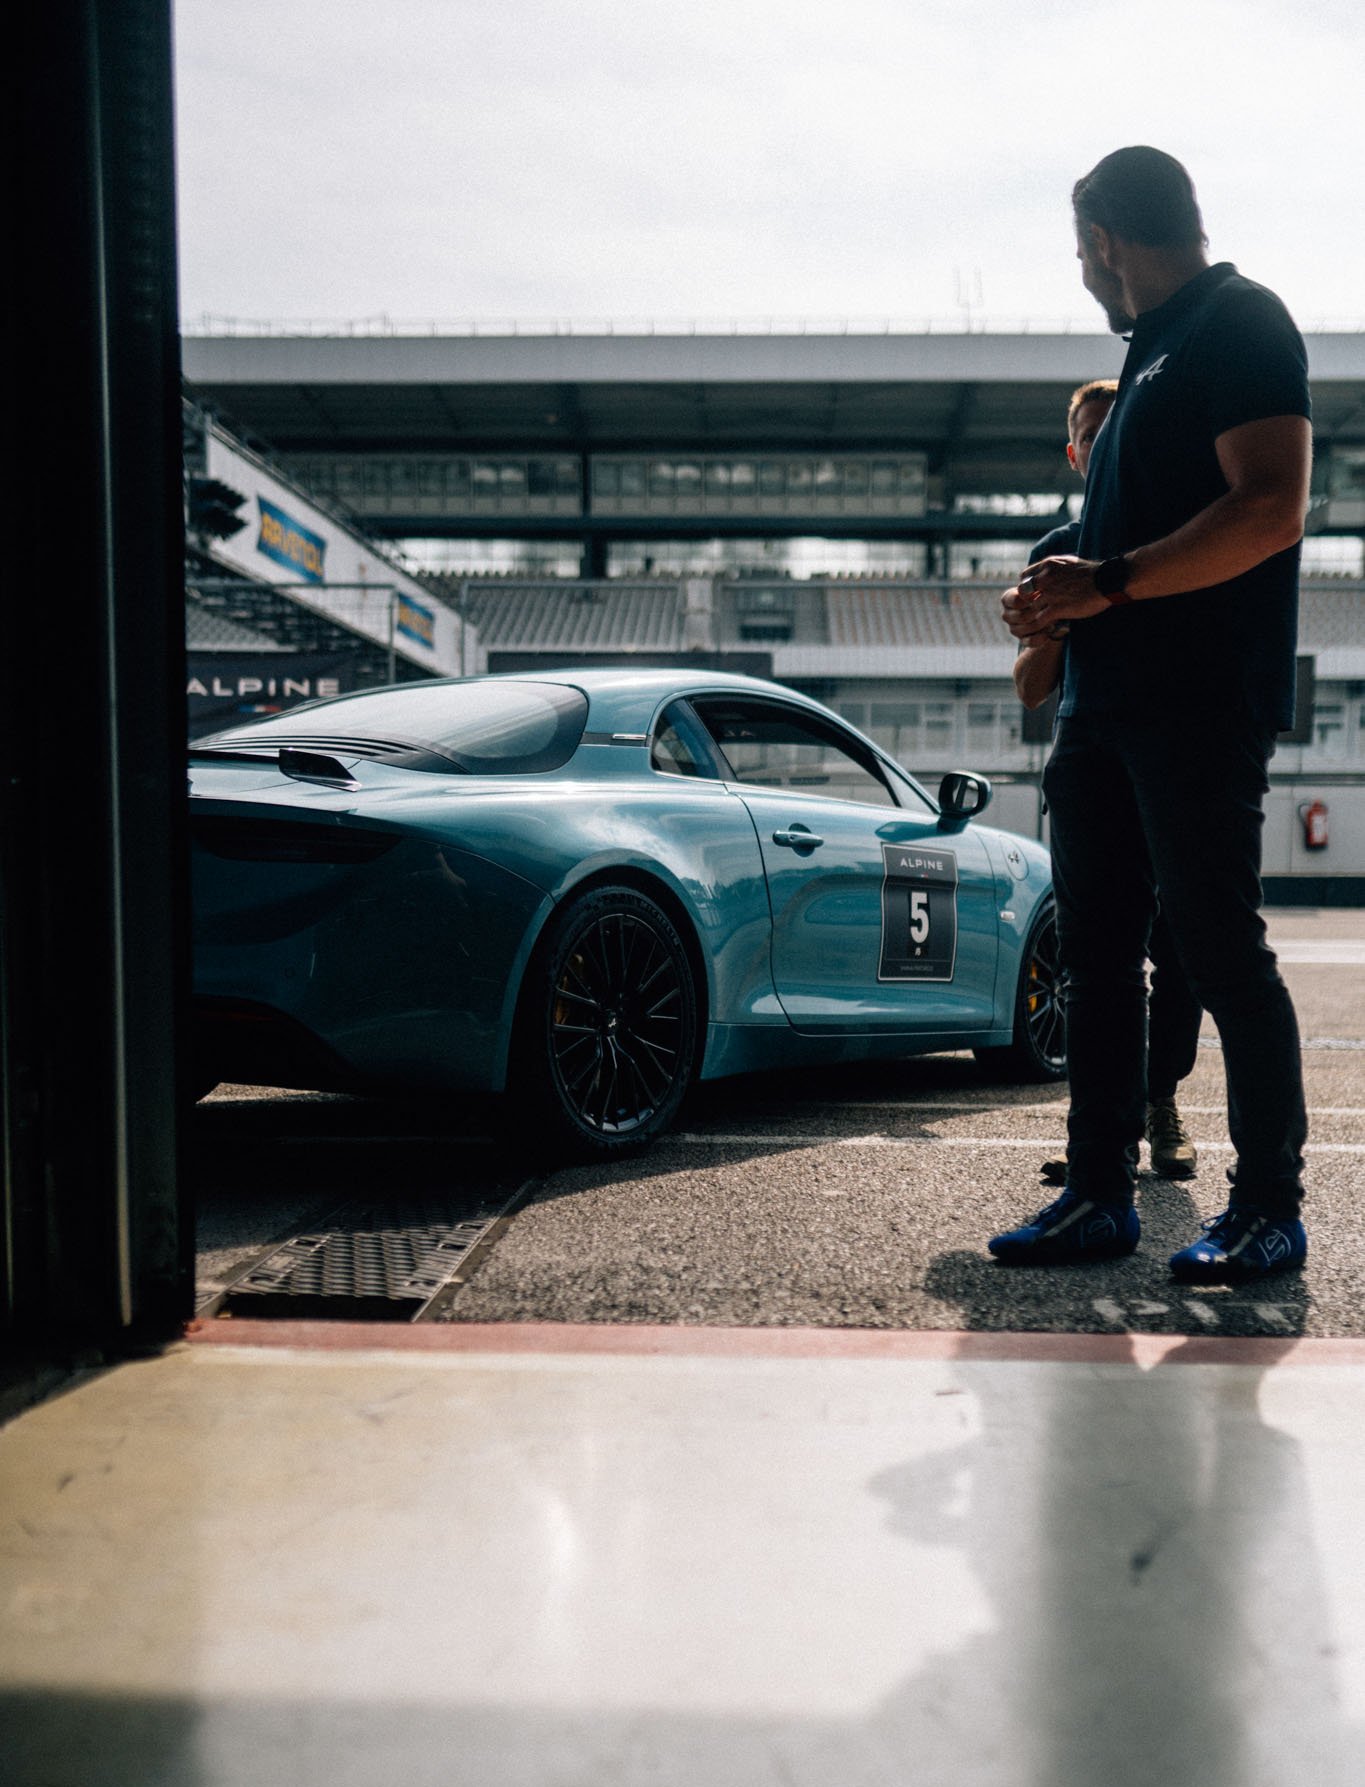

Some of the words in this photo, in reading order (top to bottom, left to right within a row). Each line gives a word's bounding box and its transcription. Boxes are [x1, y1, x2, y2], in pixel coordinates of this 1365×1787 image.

[186, 676, 340, 698] ALPINE
[900, 857, 945, 871] ALPINE
[910, 891, 930, 944] 5
